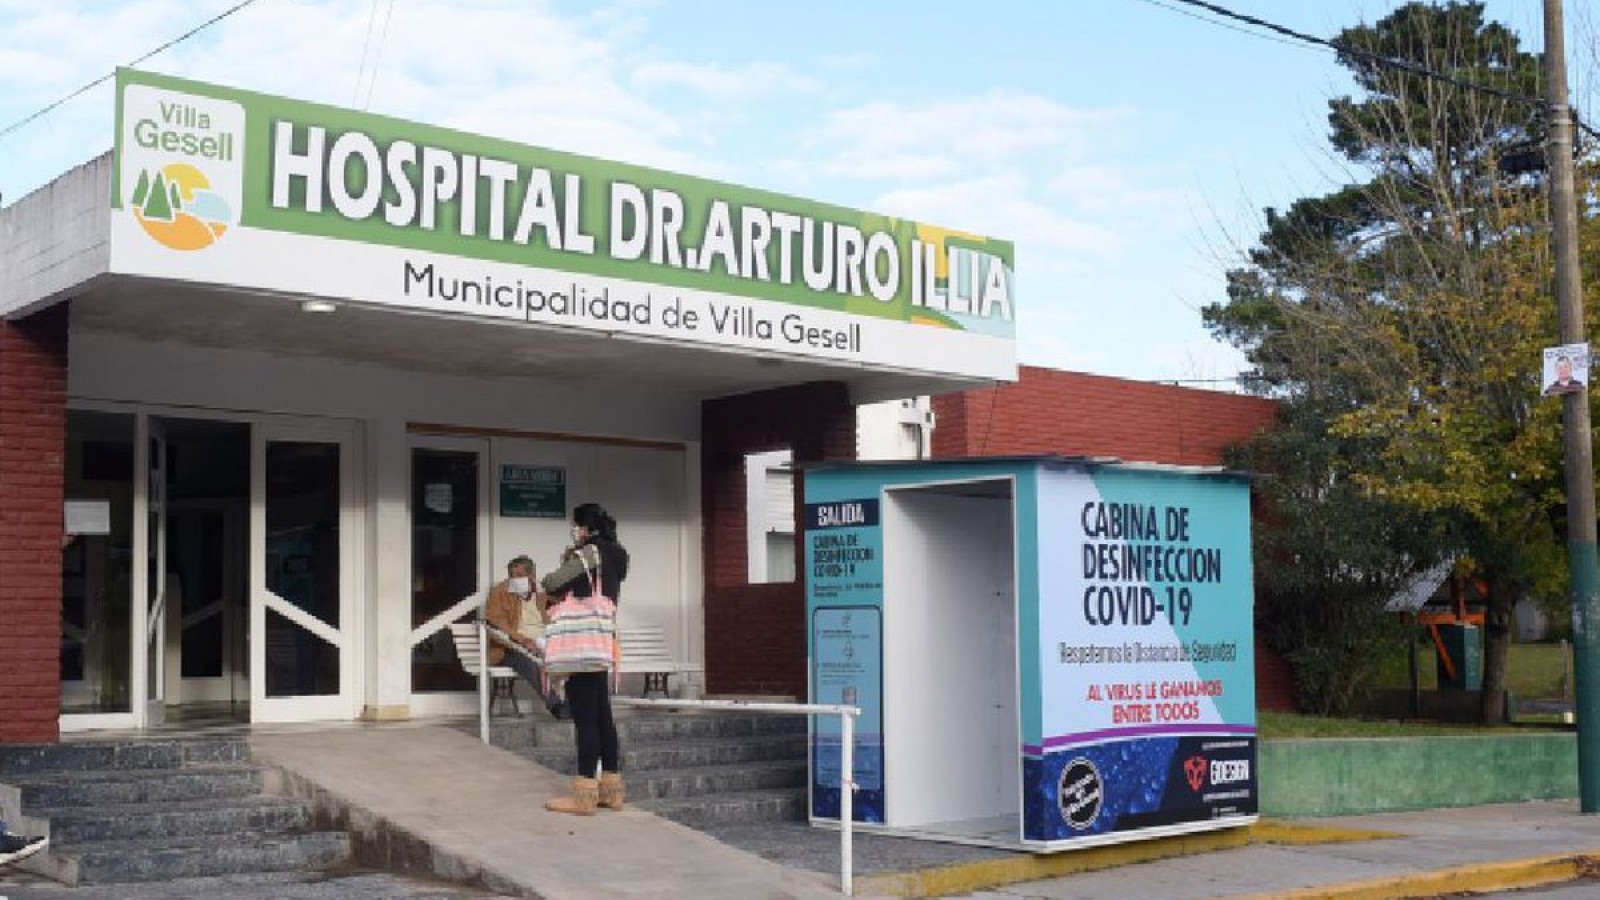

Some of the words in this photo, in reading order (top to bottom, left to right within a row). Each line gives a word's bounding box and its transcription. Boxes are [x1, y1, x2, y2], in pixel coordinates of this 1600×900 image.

[159, 100, 211, 129] Villa
[134, 118, 233, 161] Gesell
[271, 119, 595, 254] HOSPITAL
[609, 180, 900, 302] DR.ARTURO
[910, 238, 1013, 321] ILLIA
[403, 260, 652, 325] Municipalidad
[662, 297, 699, 329] de
[708, 302, 773, 341] Villa
[780, 314, 861, 353] Gesell
[817, 503, 865, 526] SALIDA
[1081, 501, 1160, 541] CABINA
[1165, 506, 1190, 541] DE
[1081, 543, 1221, 583] DESINFECCION
[1083, 586, 1193, 626] COVID-19
[1087, 684, 1103, 701] AL
[1106, 683, 1142, 701] VIRUS
[1145, 681, 1158, 700] LE
[1160, 679, 1223, 699] GANAMOS
[1112, 703, 1153, 725] ENTRE
[1155, 701, 1200, 721] TODOS
